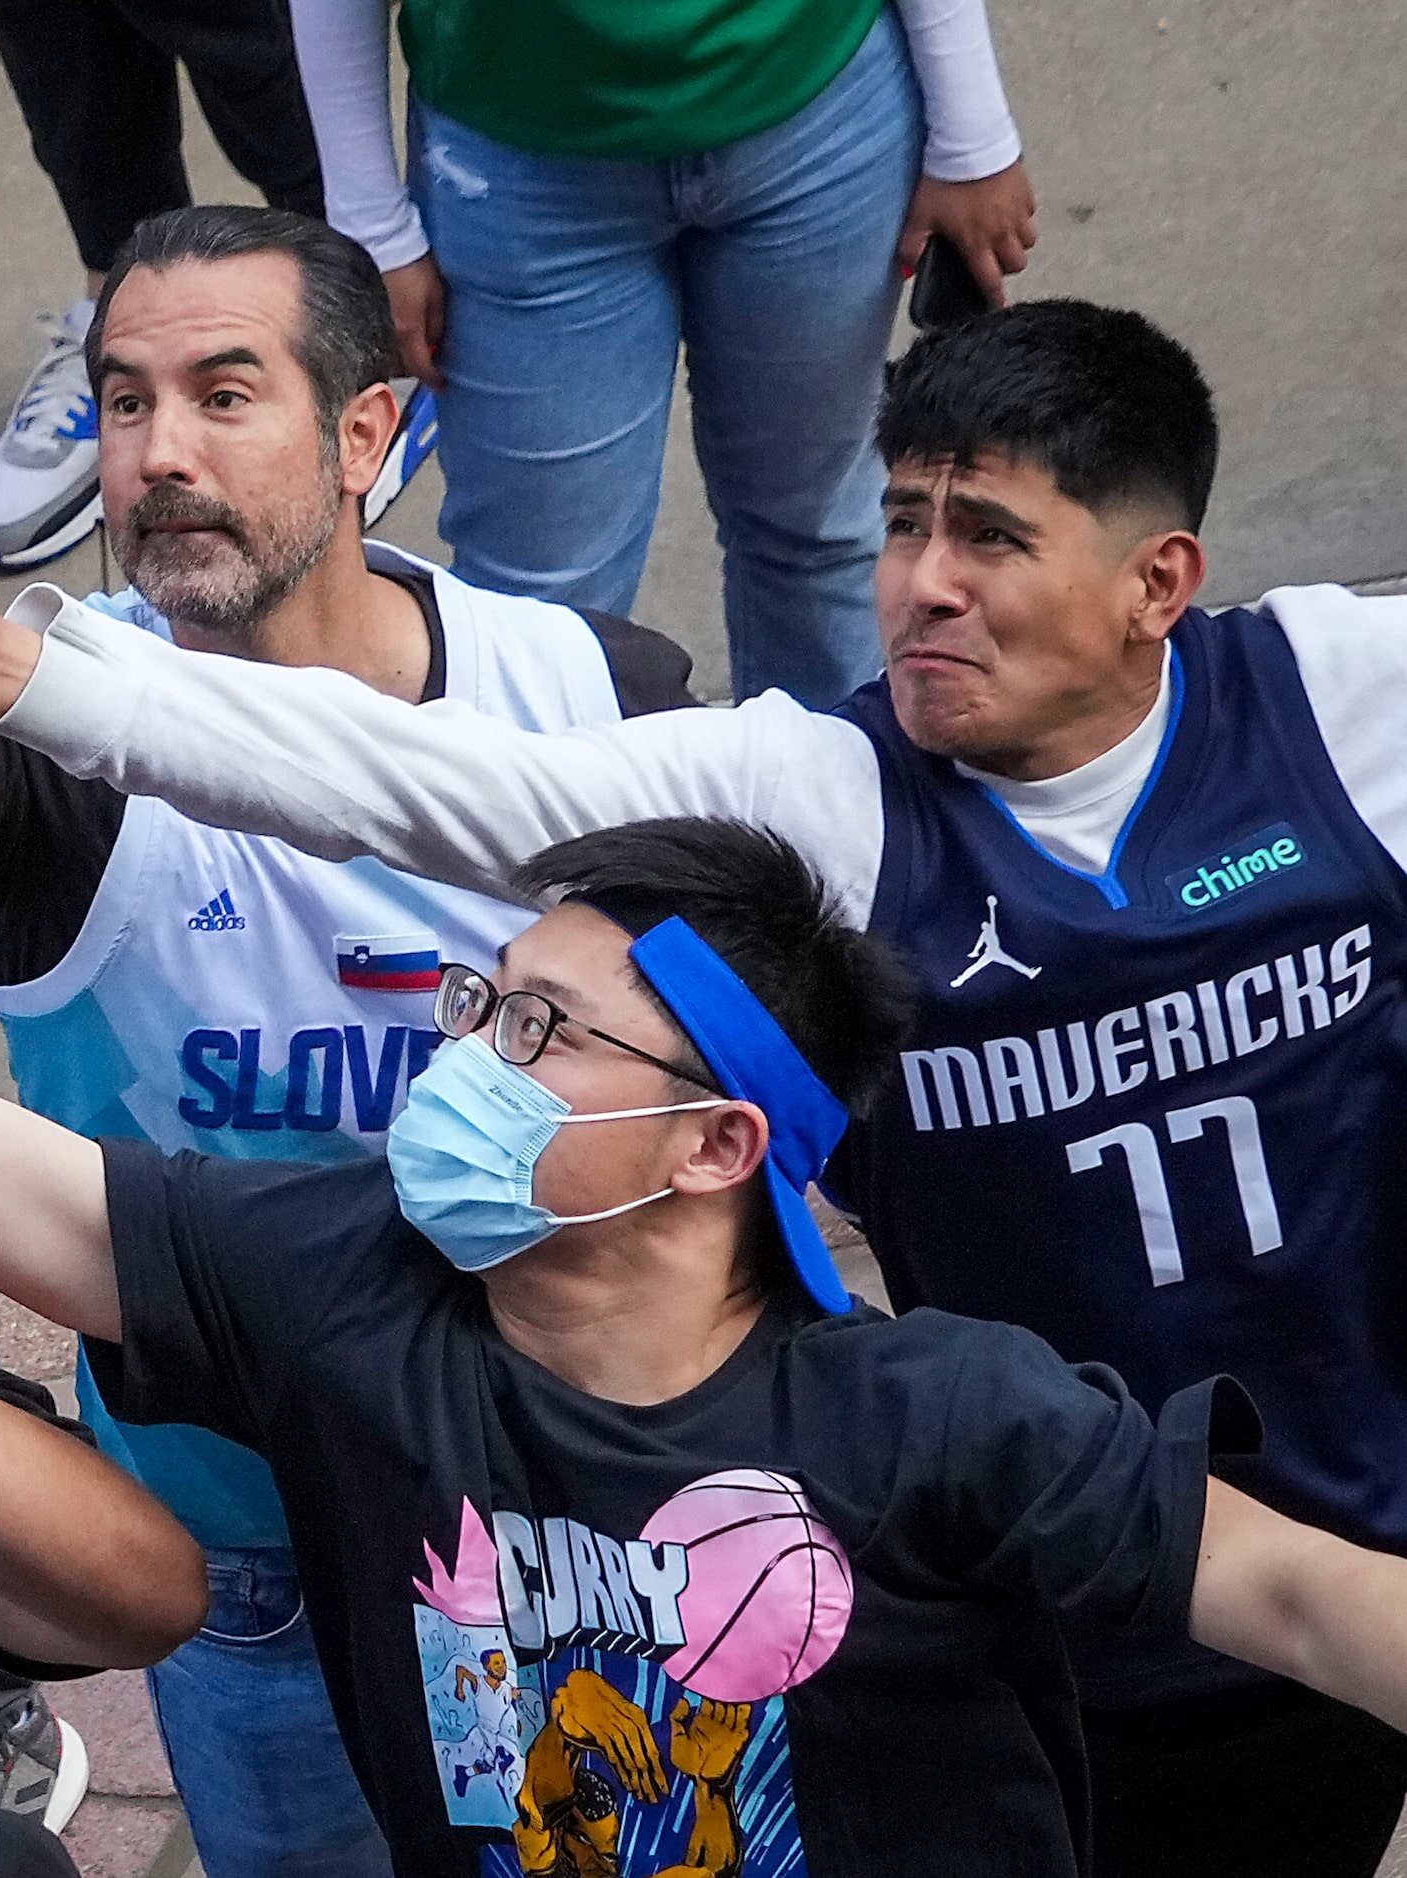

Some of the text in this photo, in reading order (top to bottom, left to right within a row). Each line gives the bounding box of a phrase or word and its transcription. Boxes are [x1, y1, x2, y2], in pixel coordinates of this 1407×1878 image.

[188, 914, 246, 932] adidas
[1181, 838, 1302, 906] chime
[900, 924, 1372, 1131] MAVERICKS
[1065, 1095, 1283, 1288] 77
[492, 1510, 688, 1650] CURRY
